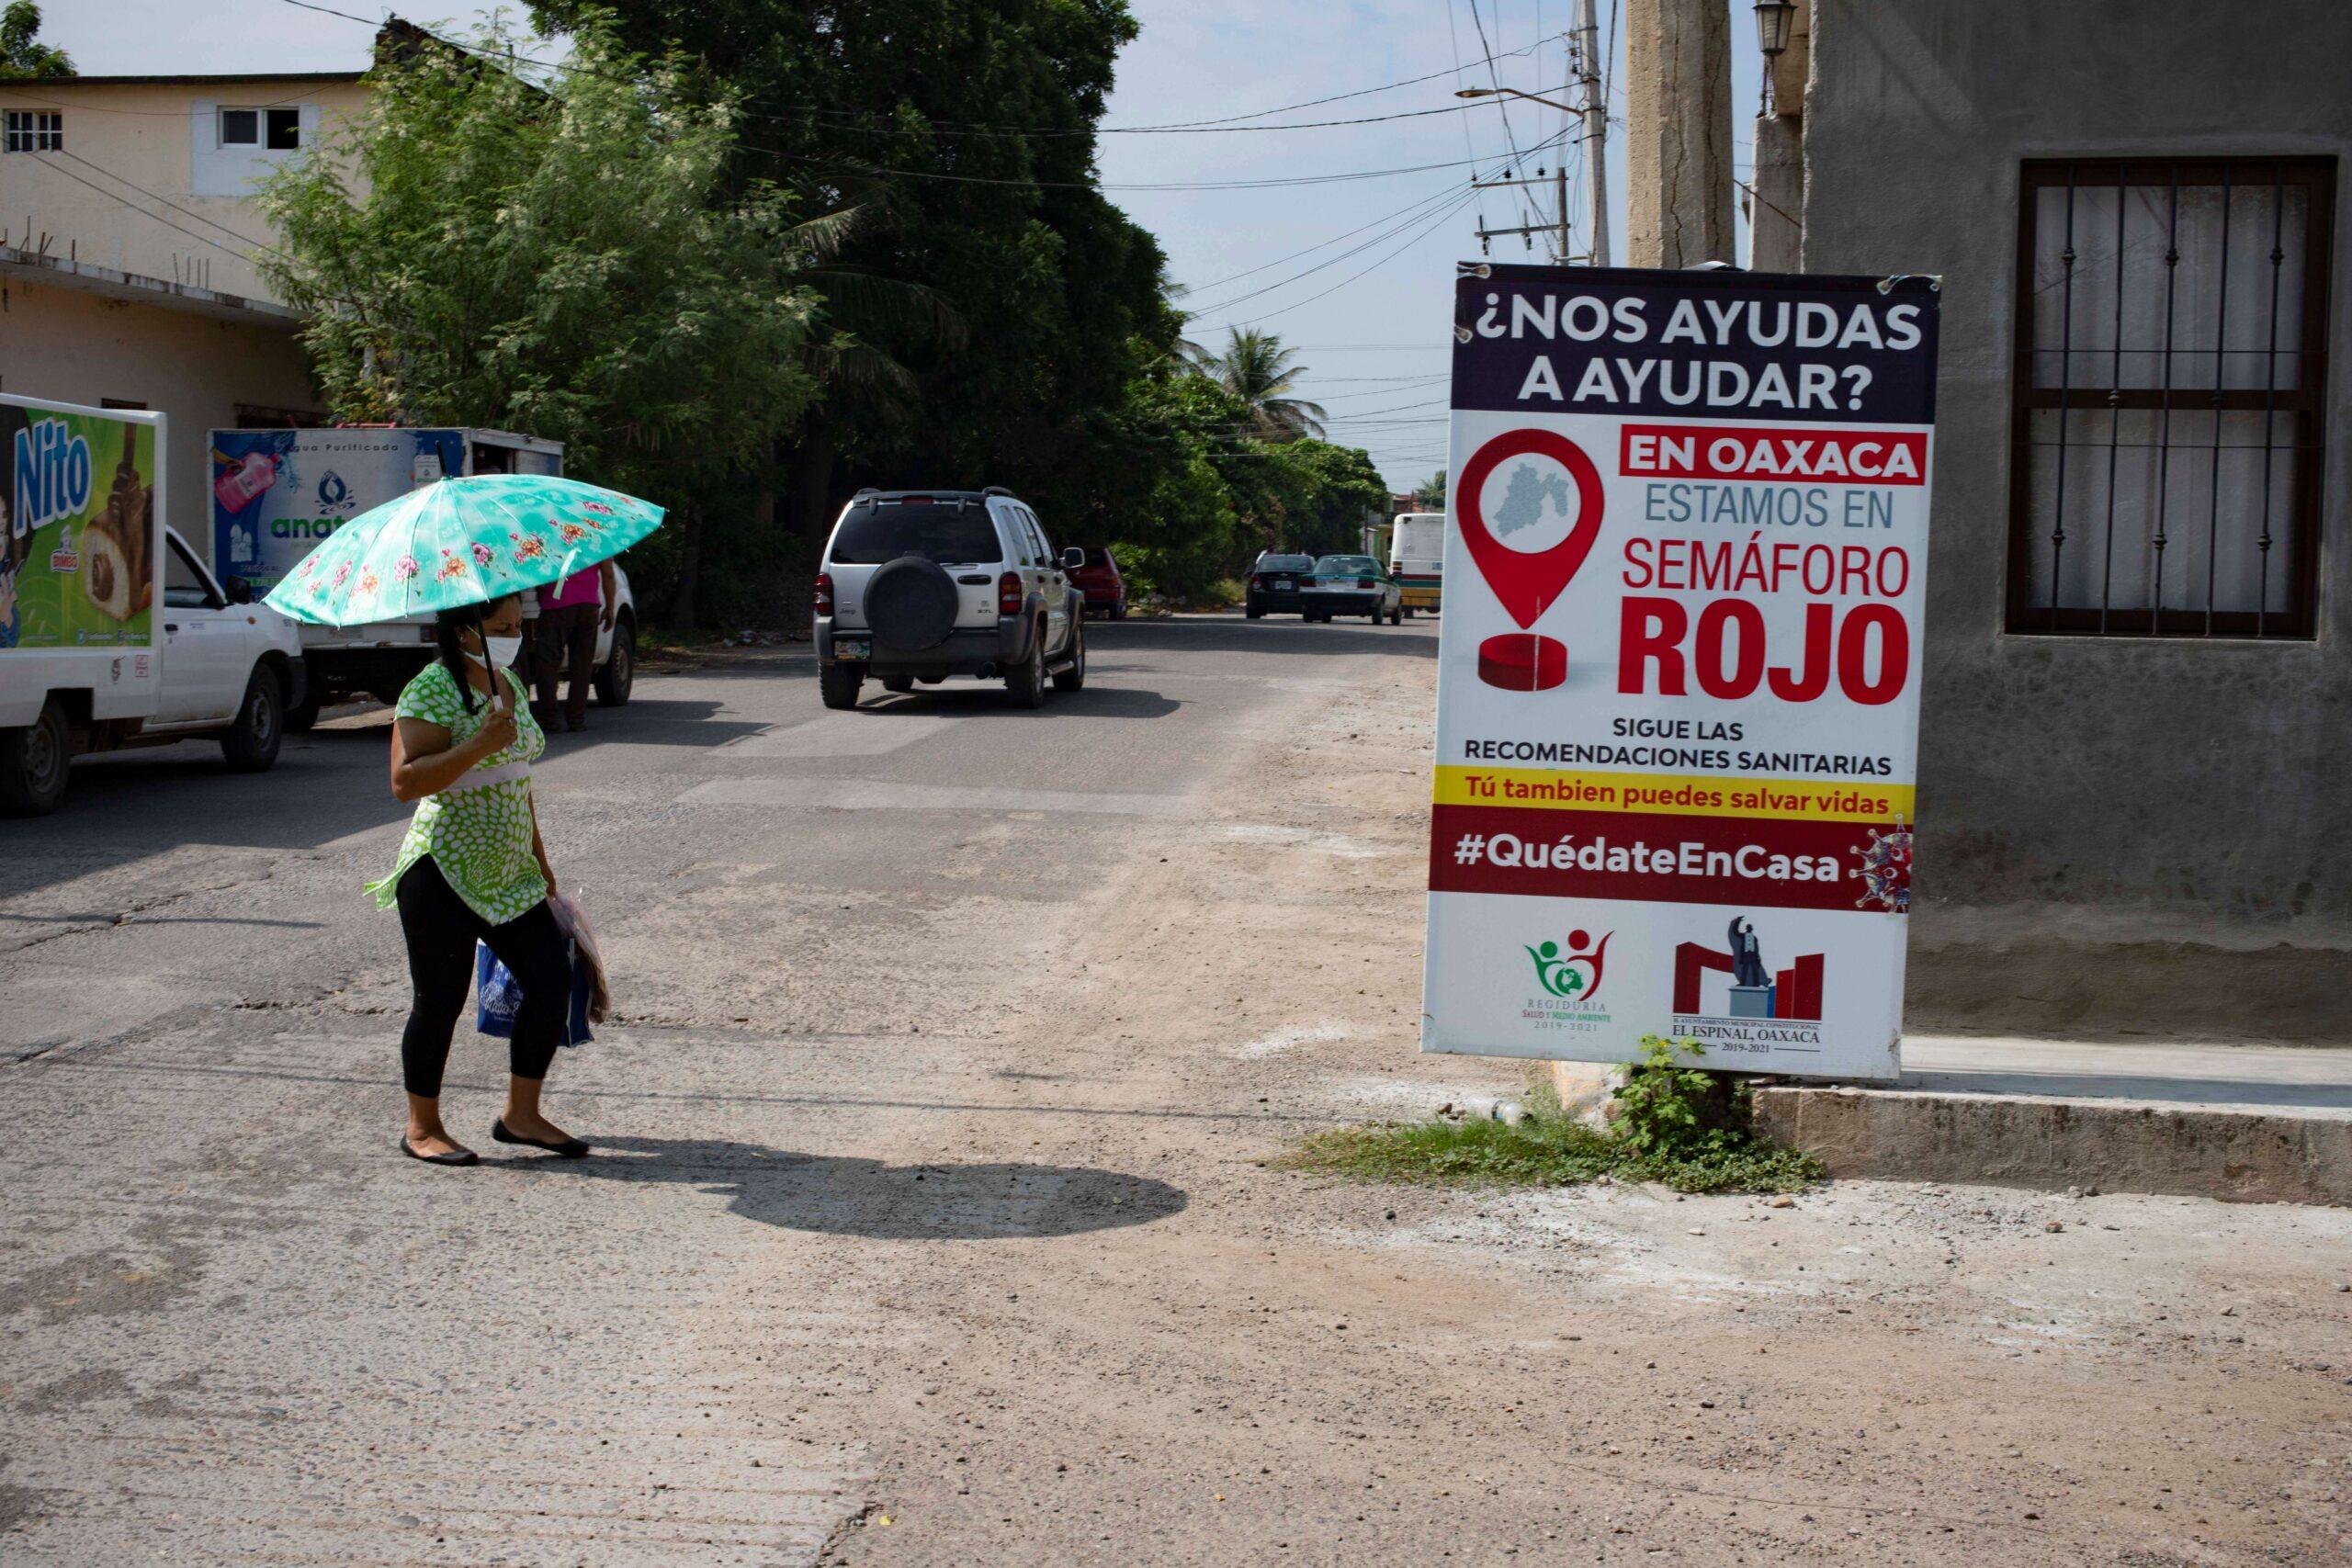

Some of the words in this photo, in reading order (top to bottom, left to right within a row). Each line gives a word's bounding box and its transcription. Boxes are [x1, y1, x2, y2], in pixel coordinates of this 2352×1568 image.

[1476, 292, 1648, 343] ¿NOS
[1659, 298, 1922, 351] AYUDAS
[1517, 355, 1565, 401] A
[1572, 356, 1873, 411] AYUDAR?
[325, 443, 399, 452] Purificada
[1628, 434, 1696, 471] EN
[1707, 437, 1919, 479] OAXACA
[15, 418, 90, 536] Nito
[1645, 482, 1828, 527] ESTAMOS
[1843, 489, 1894, 529] EN
[52, 555, 77, 569] BIMBO
[1622, 530, 1910, 598] SEMÁFORO
[1617, 595, 1909, 705] ROJO
[1612, 717, 1690, 740] SIGUE
[1697, 720, 1744, 741] LAS
[1464, 739, 1730, 770] RECOMENDACIONES
[1737, 751, 1892, 776] SANITARIAS
[1464, 775, 1497, 797] Tú
[1503, 778, 1615, 803] tambien
[1623, 784, 1723, 809] puedes
[1730, 788, 1812, 810] salvar
[1816, 790, 1890, 815] vidas
[1453, 833, 1839, 883] #QuédateEnCasa
[1527, 998, 1606, 1012] REGIDURIA
[1534, 1021, 1598, 1032] 2019-2021
[1673, 1024, 1690, 1036] EL
[1692, 1026, 1755, 1043] ESPINAL,
[1758, 1029, 1820, 1043] OAXACA
[1680, 1018, 1730, 1027] AYUNTAMIENTO
[1766, 1022, 1819, 1031] CONSTITUCIONAL
[1722, 1042, 1770, 1054] 2019-2021
